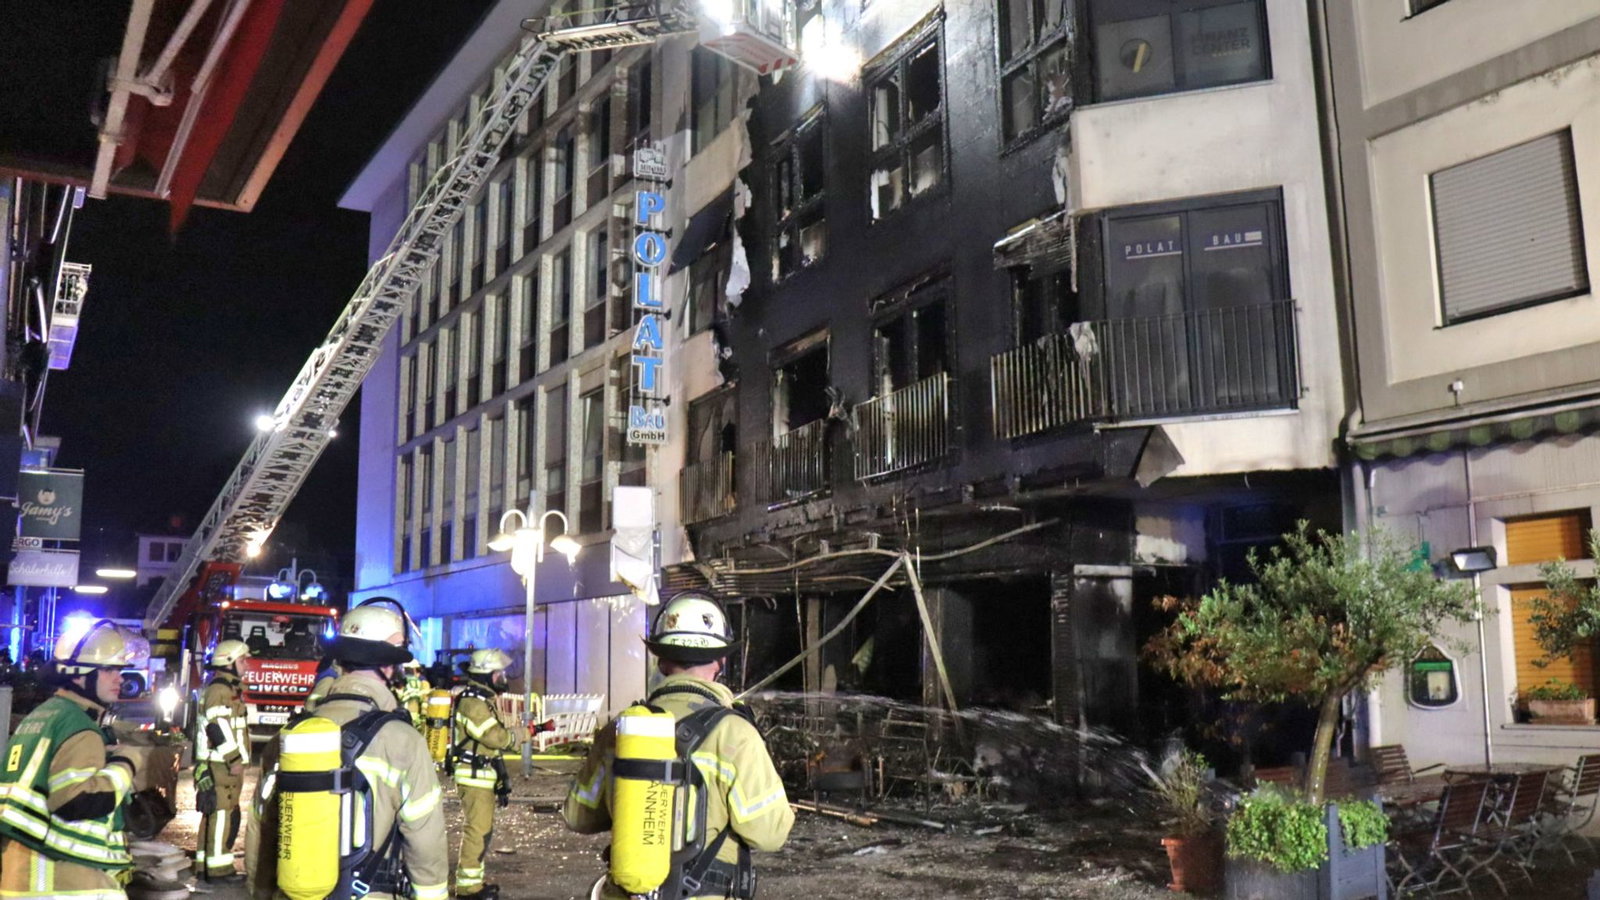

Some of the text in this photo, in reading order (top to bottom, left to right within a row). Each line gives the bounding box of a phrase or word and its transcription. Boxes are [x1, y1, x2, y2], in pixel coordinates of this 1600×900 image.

[1125, 233, 1241, 255] POLAT BAU
[633, 190, 666, 393] POLAT
[21, 502, 72, 525] Jamy's
[259, 684, 298, 693] IVECO
